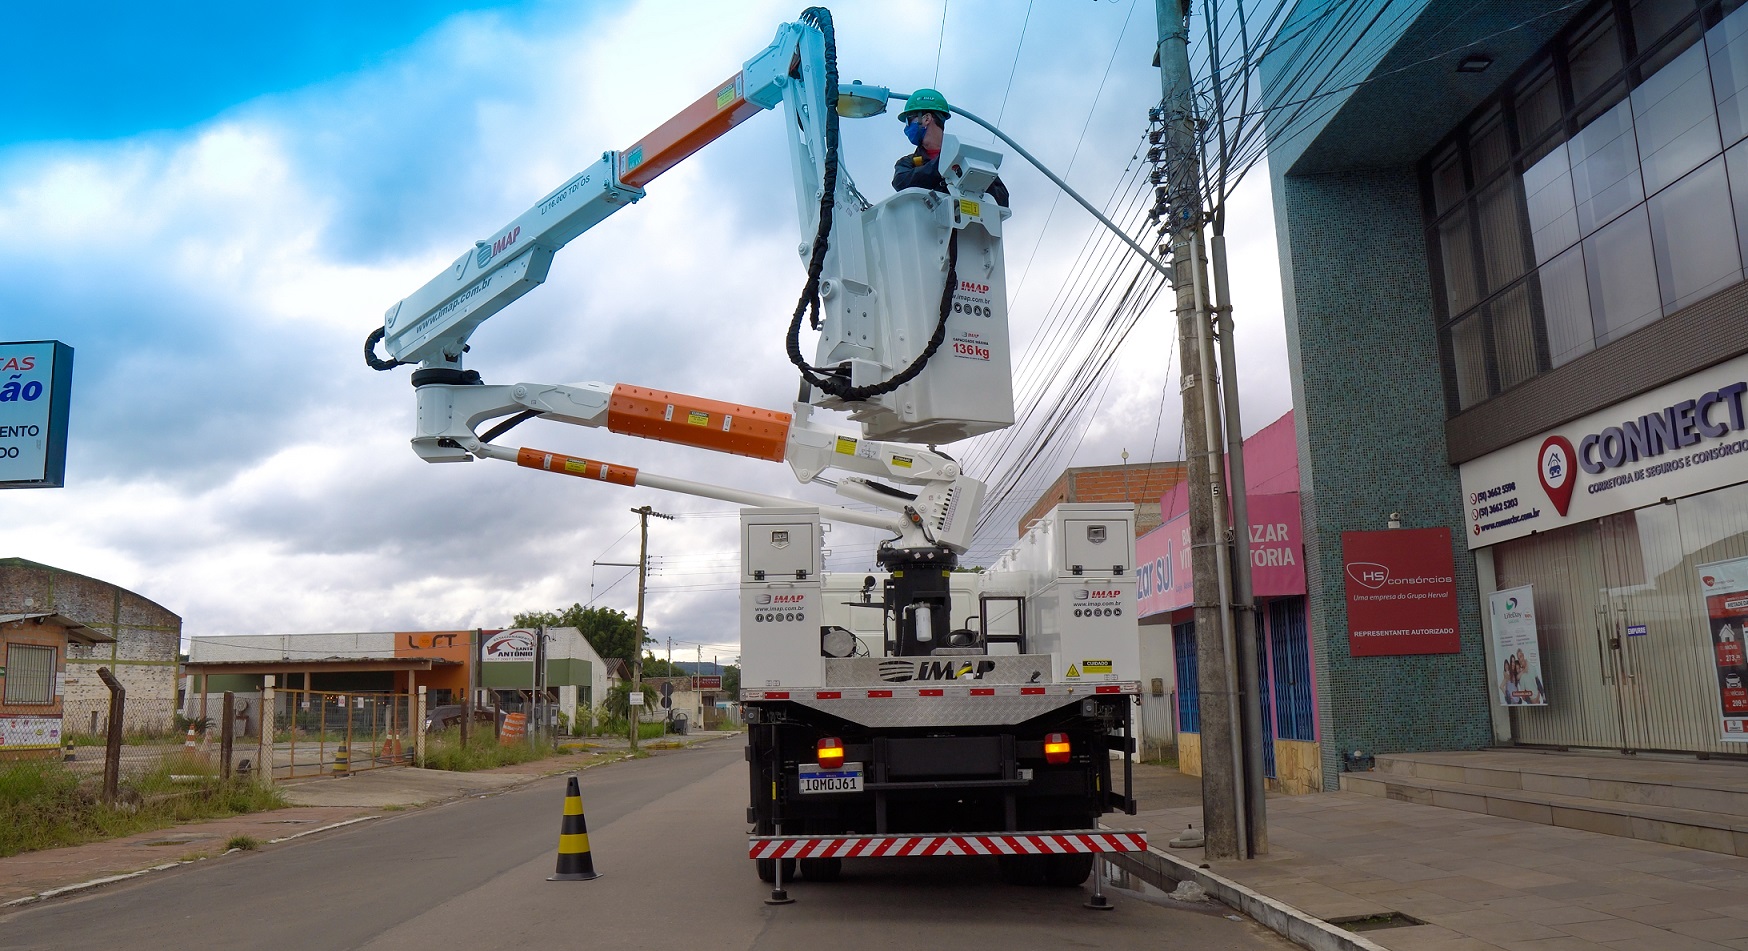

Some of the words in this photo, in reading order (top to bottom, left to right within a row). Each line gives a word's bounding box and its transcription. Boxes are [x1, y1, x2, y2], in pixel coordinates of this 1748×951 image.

[580, 174, 591, 187] OS
[490, 225, 521, 258] IMAP
[961, 281, 990, 294] IMAP
[416, 277, 493, 334] www.imap.com.br
[953, 342, 974, 355] 136
[975, 345, 990, 360] kg
[0, 373, 43, 402] ão
[0, 424, 40, 438] ENTO
[1578, 381, 1748, 474] CONNECT
[1588, 473, 1635, 495] CORRETORA
[1634, 469, 1645, 482] DE
[1645, 458, 1685, 478] SEGUROS
[1685, 455, 1692, 468] E
[1477, 490, 1488, 504] (51)
[1487, 486, 1502, 499] 3662
[1479, 506, 1489, 519] (51)
[1489, 502, 1503, 514] 3662
[1503, 497, 1519, 510] 5203
[1155, 538, 1175, 595] sul
[1363, 571, 1385, 581] HS
[1387, 576, 1453, 585] consórcios
[773, 594, 804, 604] IMAP
[1091, 590, 1121, 599] IMAP
[1369, 594, 1397, 602] empresa
[1406, 592, 1427, 601] Grupo
[1427, 591, 1449, 599] Herval
[1073, 600, 1122, 608] www.imap.com.br
[1354, 629, 1410, 637] REPRESENTANTE
[1411, 628, 1454, 636] AUTORIZADO
[1627, 626, 1646, 635] EMPURRE
[914, 660, 996, 681] IMAP
